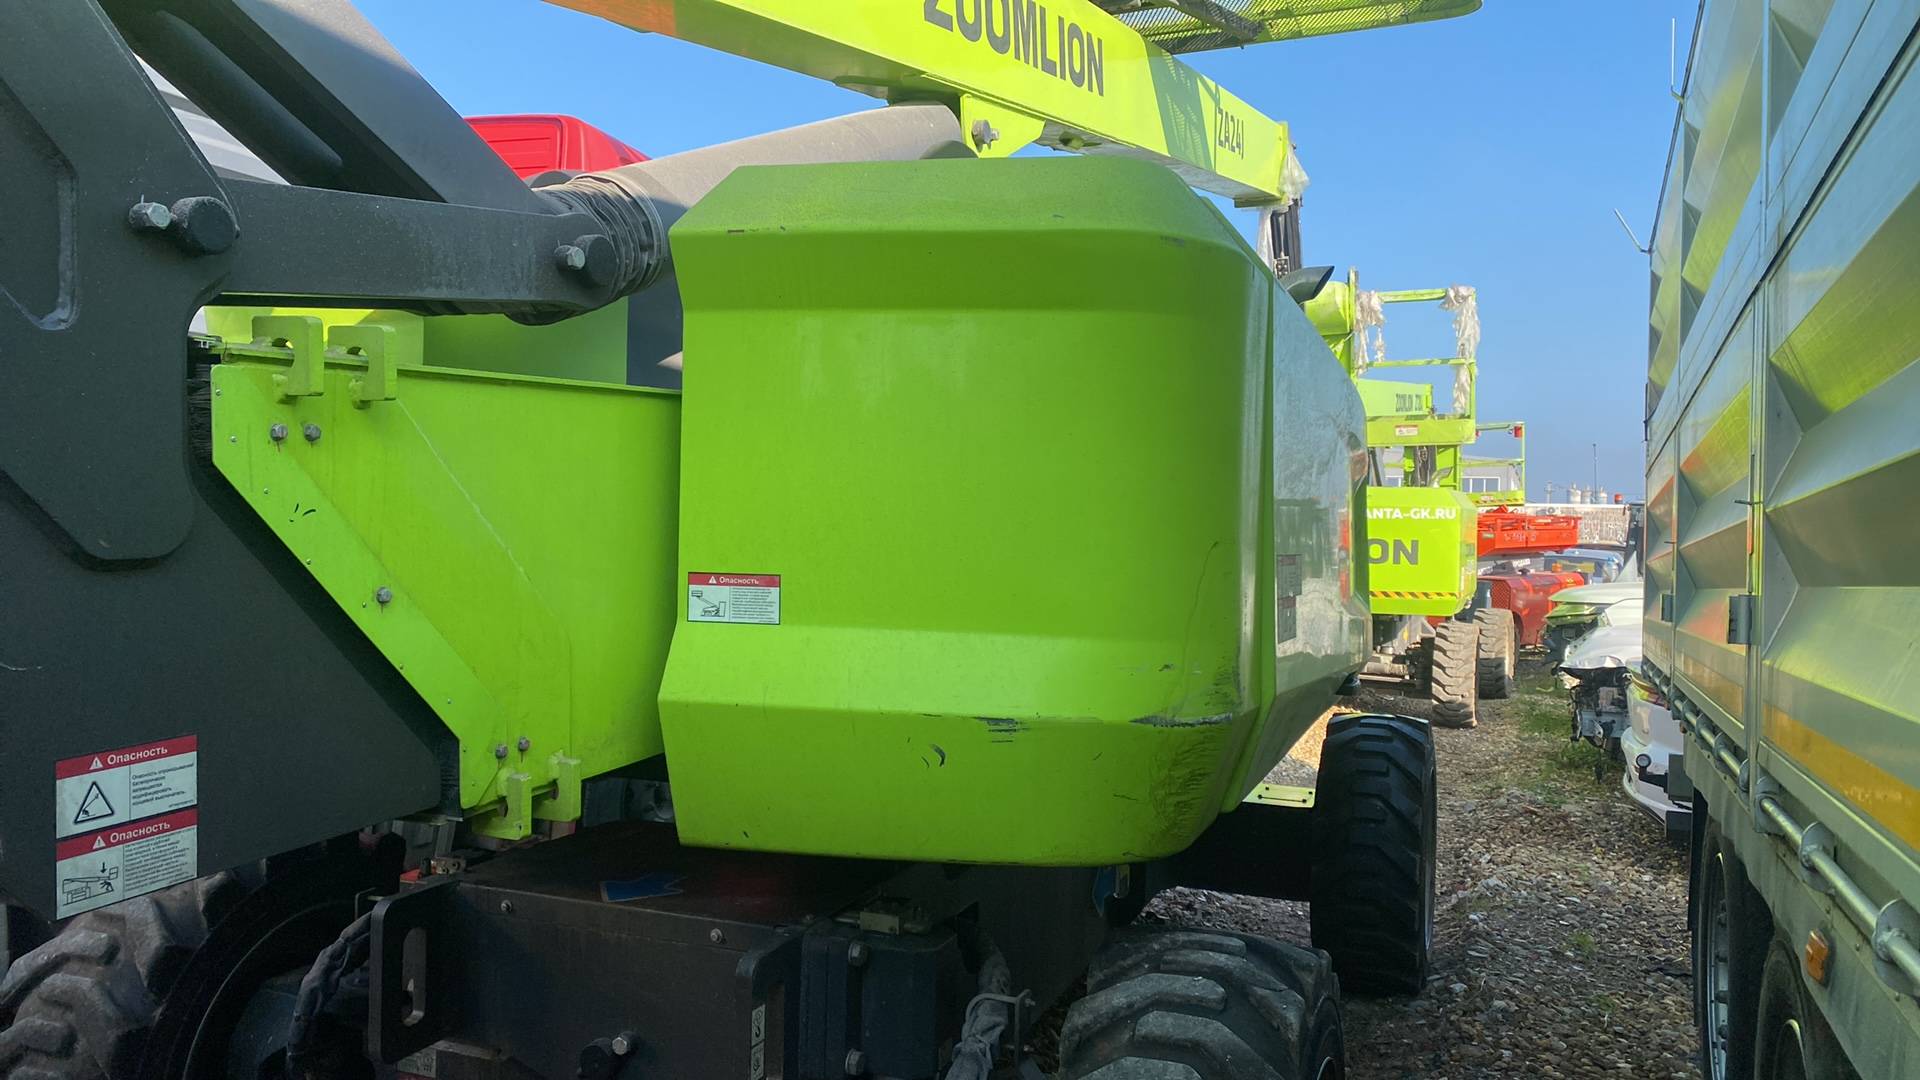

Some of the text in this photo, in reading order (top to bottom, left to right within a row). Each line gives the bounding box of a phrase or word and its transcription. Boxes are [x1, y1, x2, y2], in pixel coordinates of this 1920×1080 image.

[719, 576, 759, 585] Опасность
[107, 747, 168, 765] Опасность
[110, 822, 171, 843] Опасность
